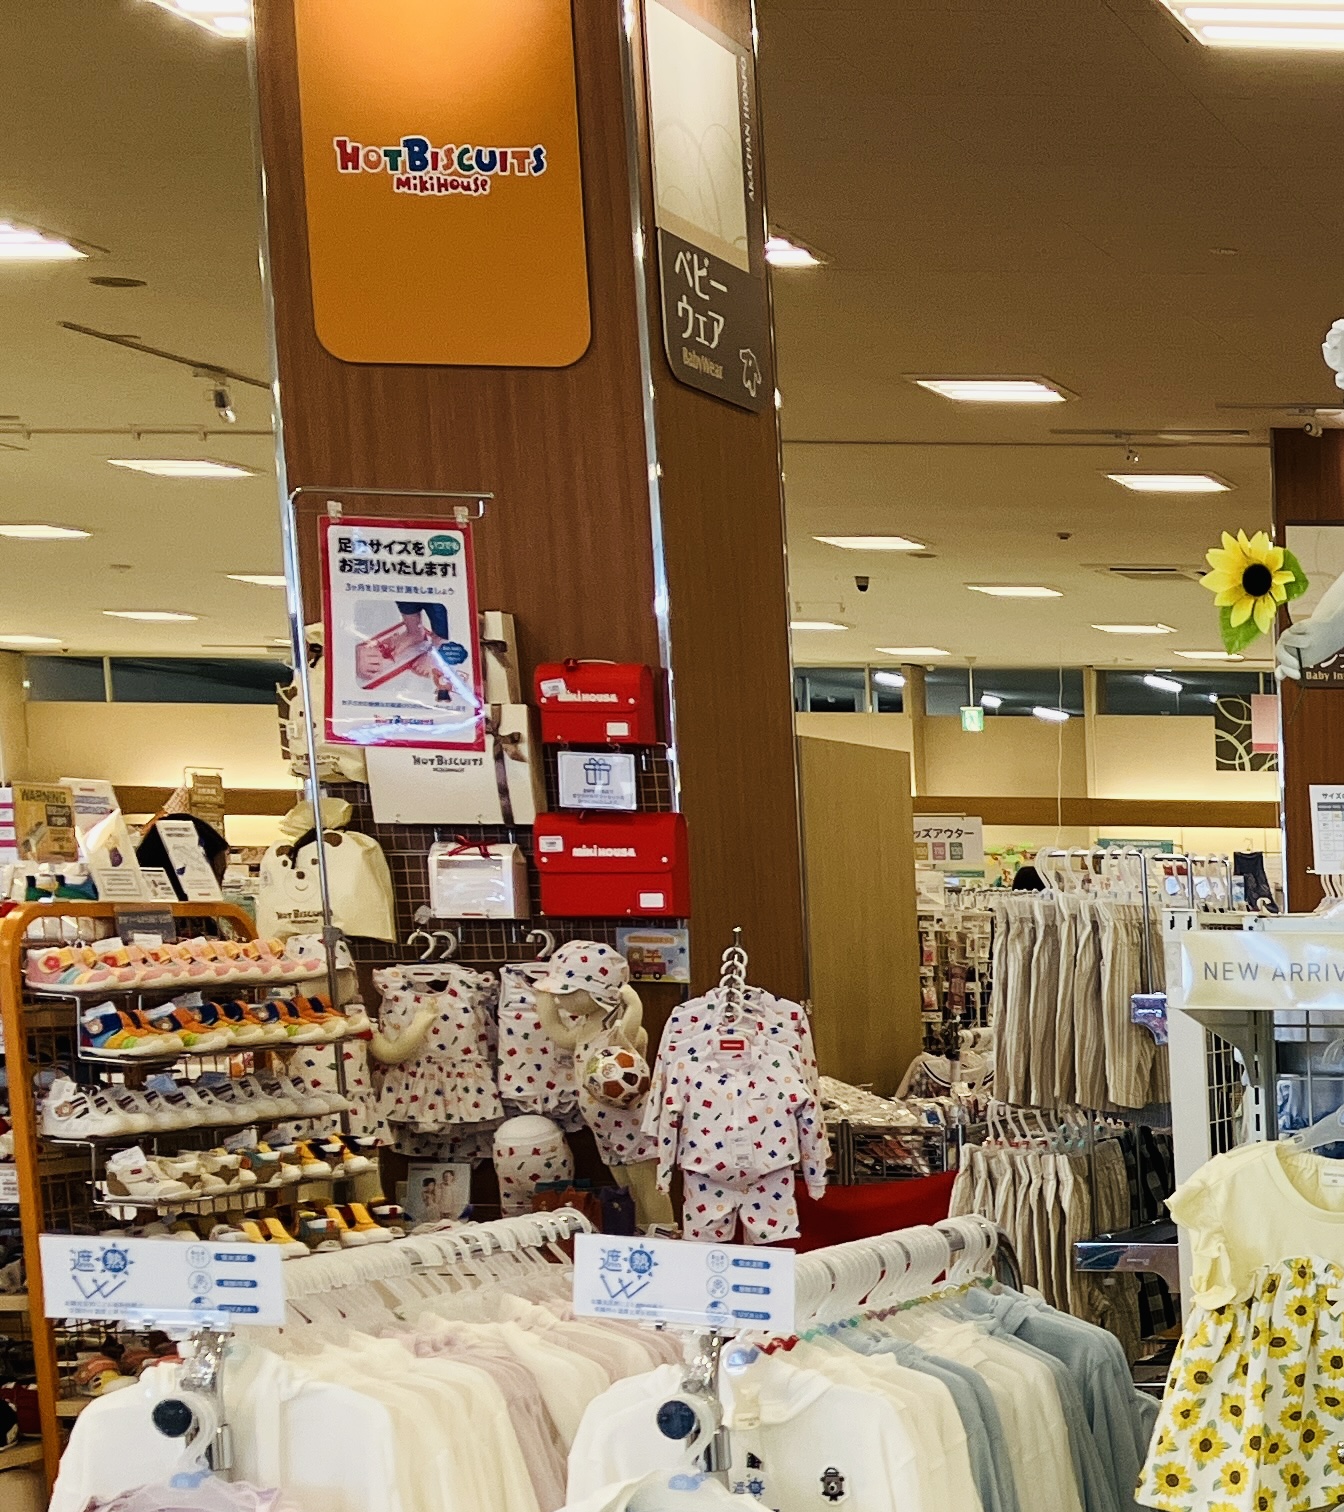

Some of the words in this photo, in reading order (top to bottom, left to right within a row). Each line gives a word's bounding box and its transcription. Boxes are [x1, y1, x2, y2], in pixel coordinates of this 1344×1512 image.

[675, 251, 728, 300] ベビー
[677, 295, 725, 350] ウェア
[1305, 671, 1330, 681] Baby
[21, 788, 66, 804] WARNING
[1204, 961, 1259, 982] NEW
